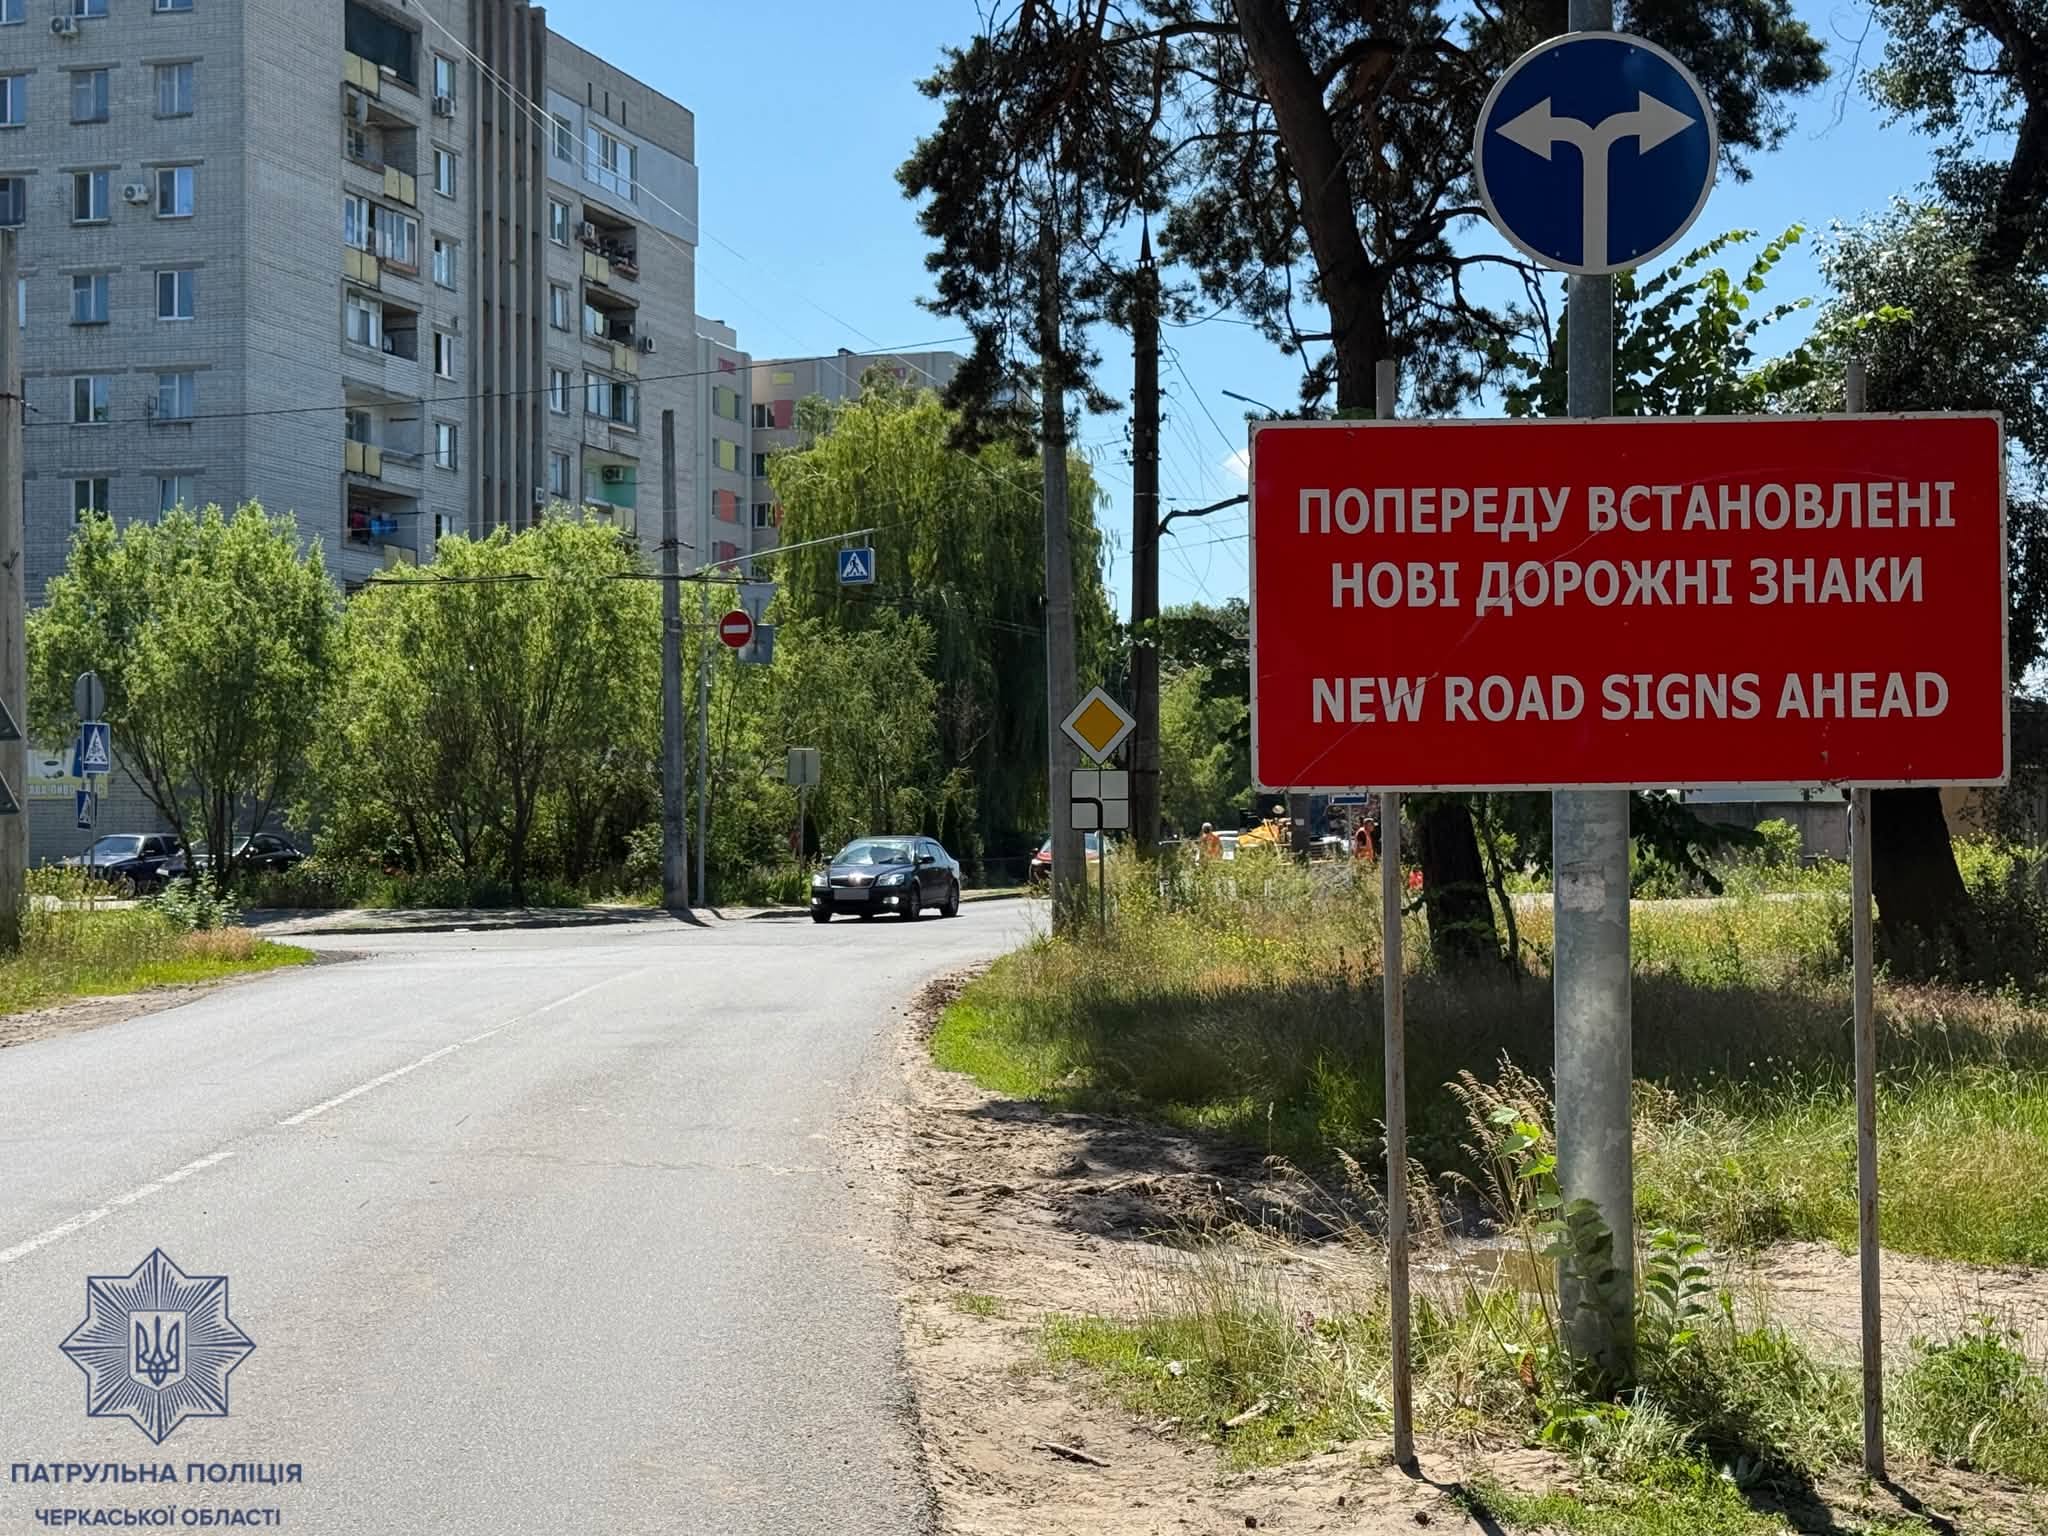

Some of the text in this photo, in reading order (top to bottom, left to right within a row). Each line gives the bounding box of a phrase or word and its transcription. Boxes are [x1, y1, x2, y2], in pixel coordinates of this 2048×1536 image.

[1300, 482, 1955, 541] ПОПЕРЕДУ ВСТАНОВЛЕНІ
[1332, 557, 1922, 617] НОВІ ДОРОЖНІ ЗНАКИ
[1313, 672, 1949, 723] NEW ROAD SIGNS AHEAD
